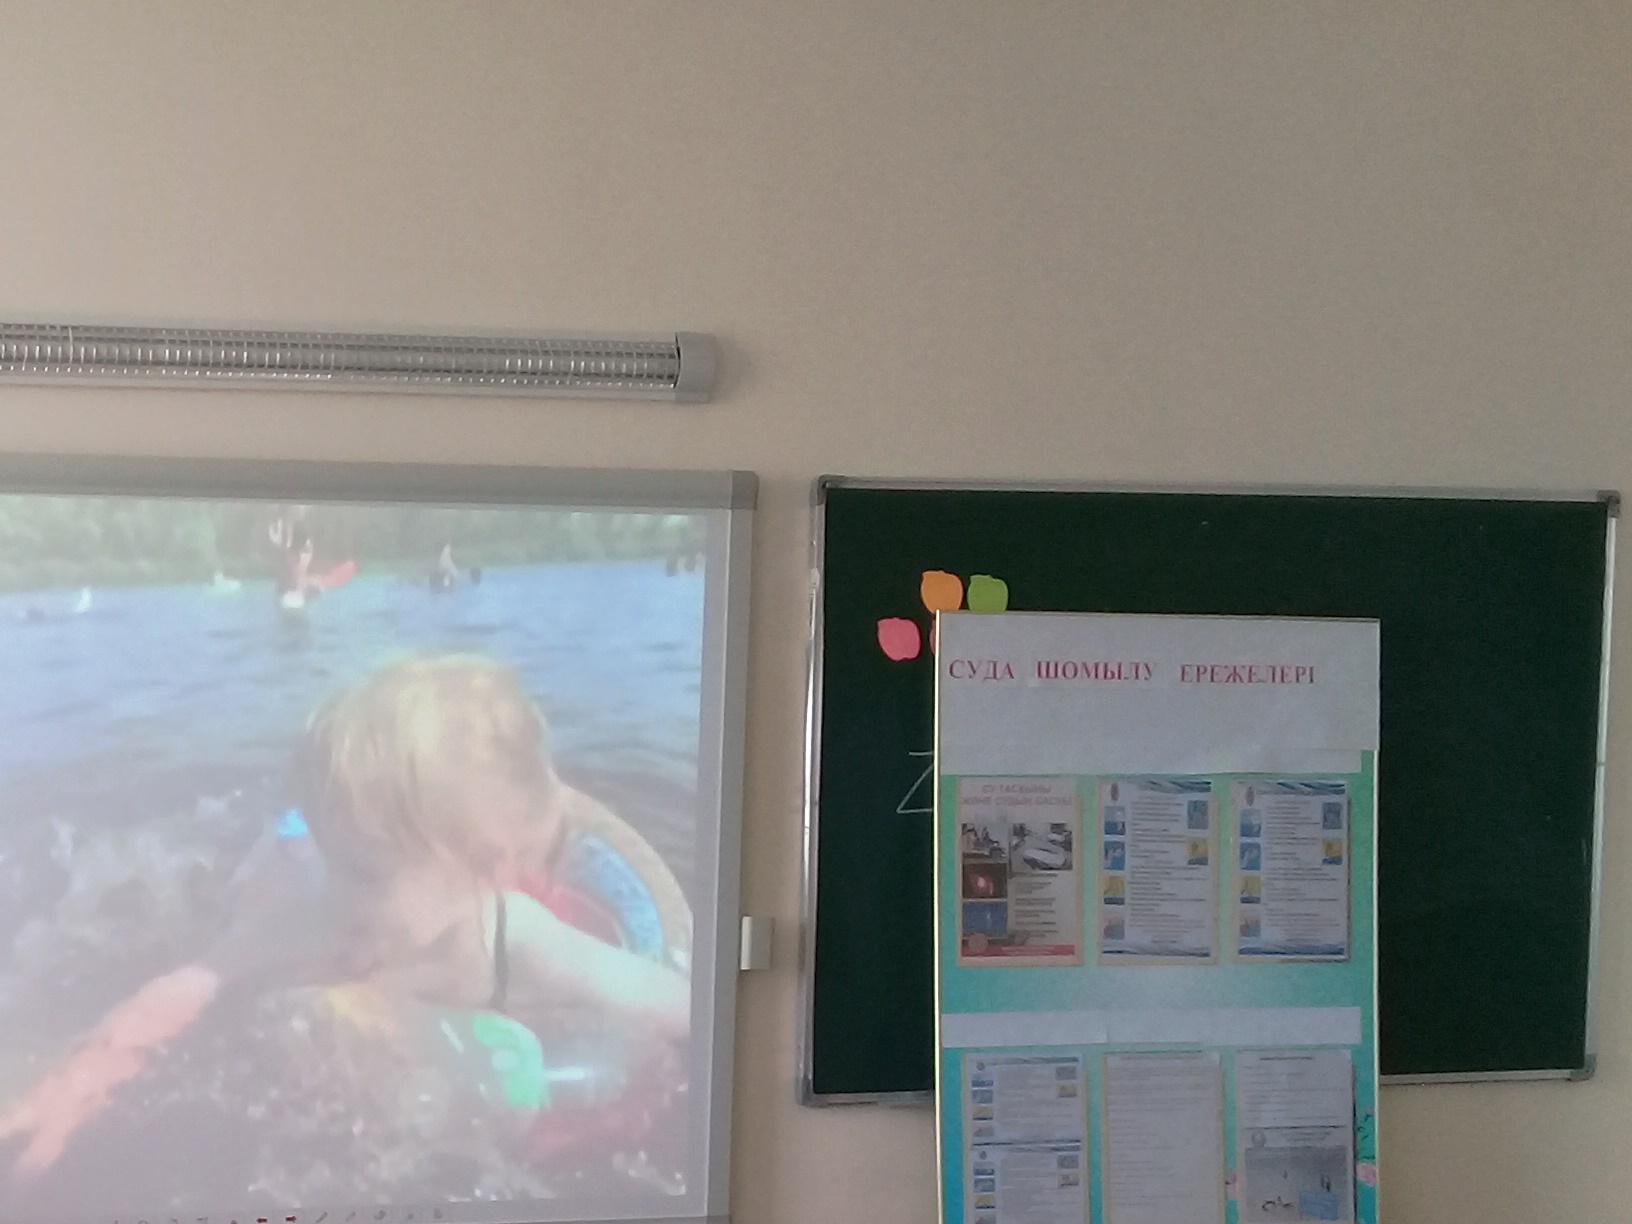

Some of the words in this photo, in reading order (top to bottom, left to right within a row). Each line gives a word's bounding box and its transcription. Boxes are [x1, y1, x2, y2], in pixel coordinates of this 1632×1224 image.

[948, 659, 1015, 681] СУДА
[1036, 660, 1155, 681] ШОМЫЛУ
[1180, 664, 1316, 684] ЕРЕЖЕЛЕРІ
